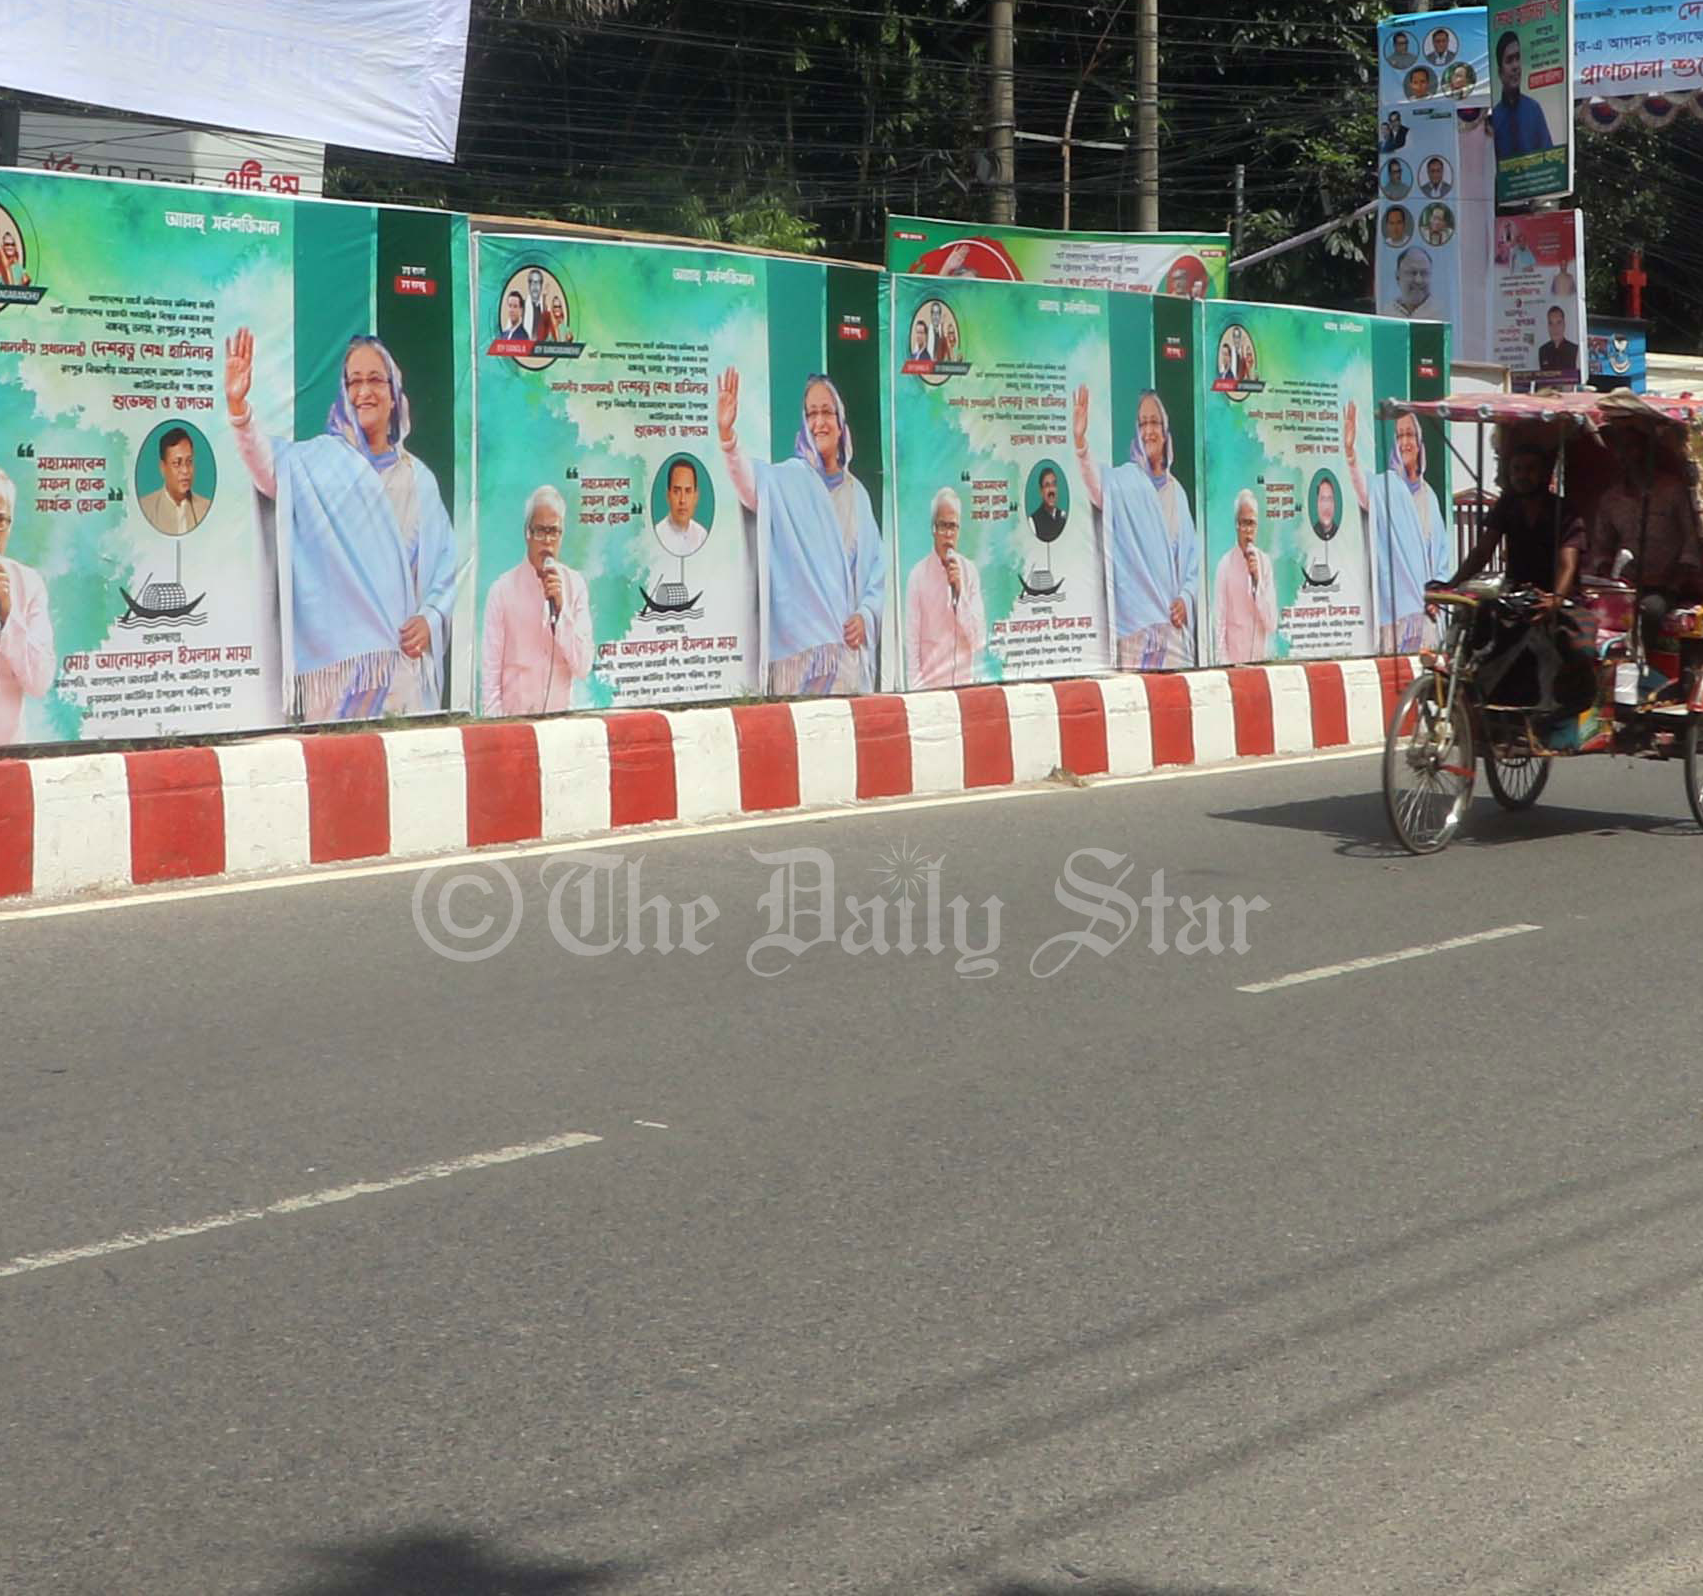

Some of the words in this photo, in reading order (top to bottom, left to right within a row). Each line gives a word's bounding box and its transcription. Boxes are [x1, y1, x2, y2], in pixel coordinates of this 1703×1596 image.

[1608, 35, 1651, 52] আগমন
[1580, 58, 1664, 86] প্রাণঢালা
[37, 456, 106, 471] মহাসমাবেশ
[38, 478, 70, 491] সফল
[75, 478, 105, 493] হোক
[76, 499, 106, 514] হোক
[178, 645, 221, 663] ইসলাম
[226, 645, 252, 661] মায়া
